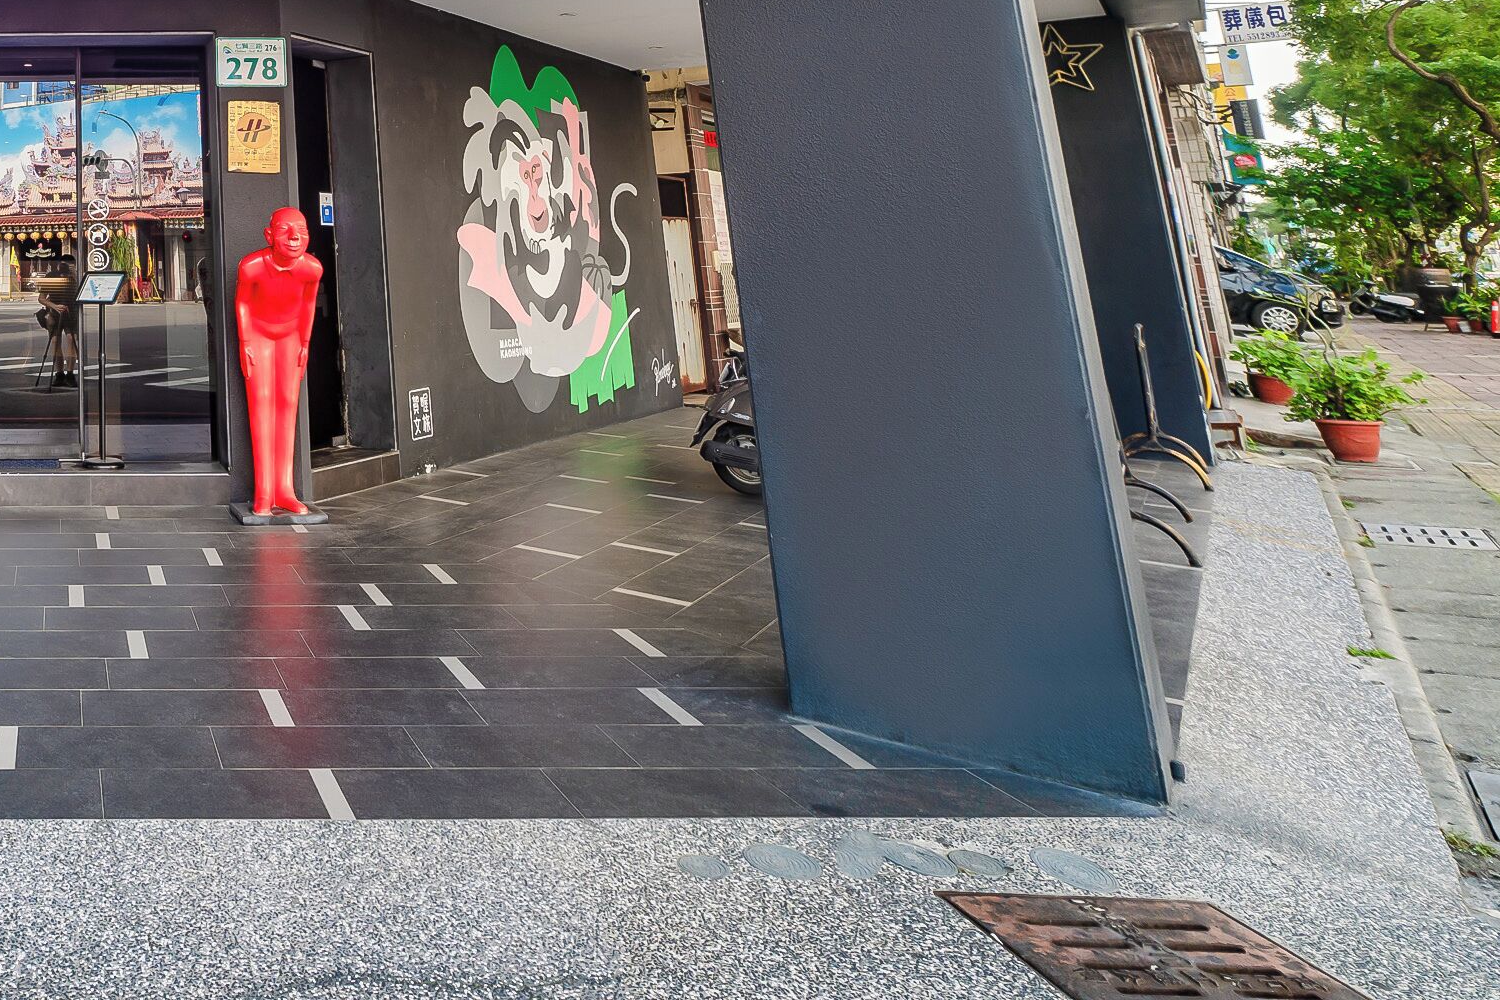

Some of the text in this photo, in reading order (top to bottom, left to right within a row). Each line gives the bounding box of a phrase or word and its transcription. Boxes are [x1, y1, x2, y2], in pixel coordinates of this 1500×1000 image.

[1227, 34, 1245, 42] TEL
[264, 44, 278, 52] 276
[226, 57, 278, 80] 278
[499, 337, 523, 349] MACACA
